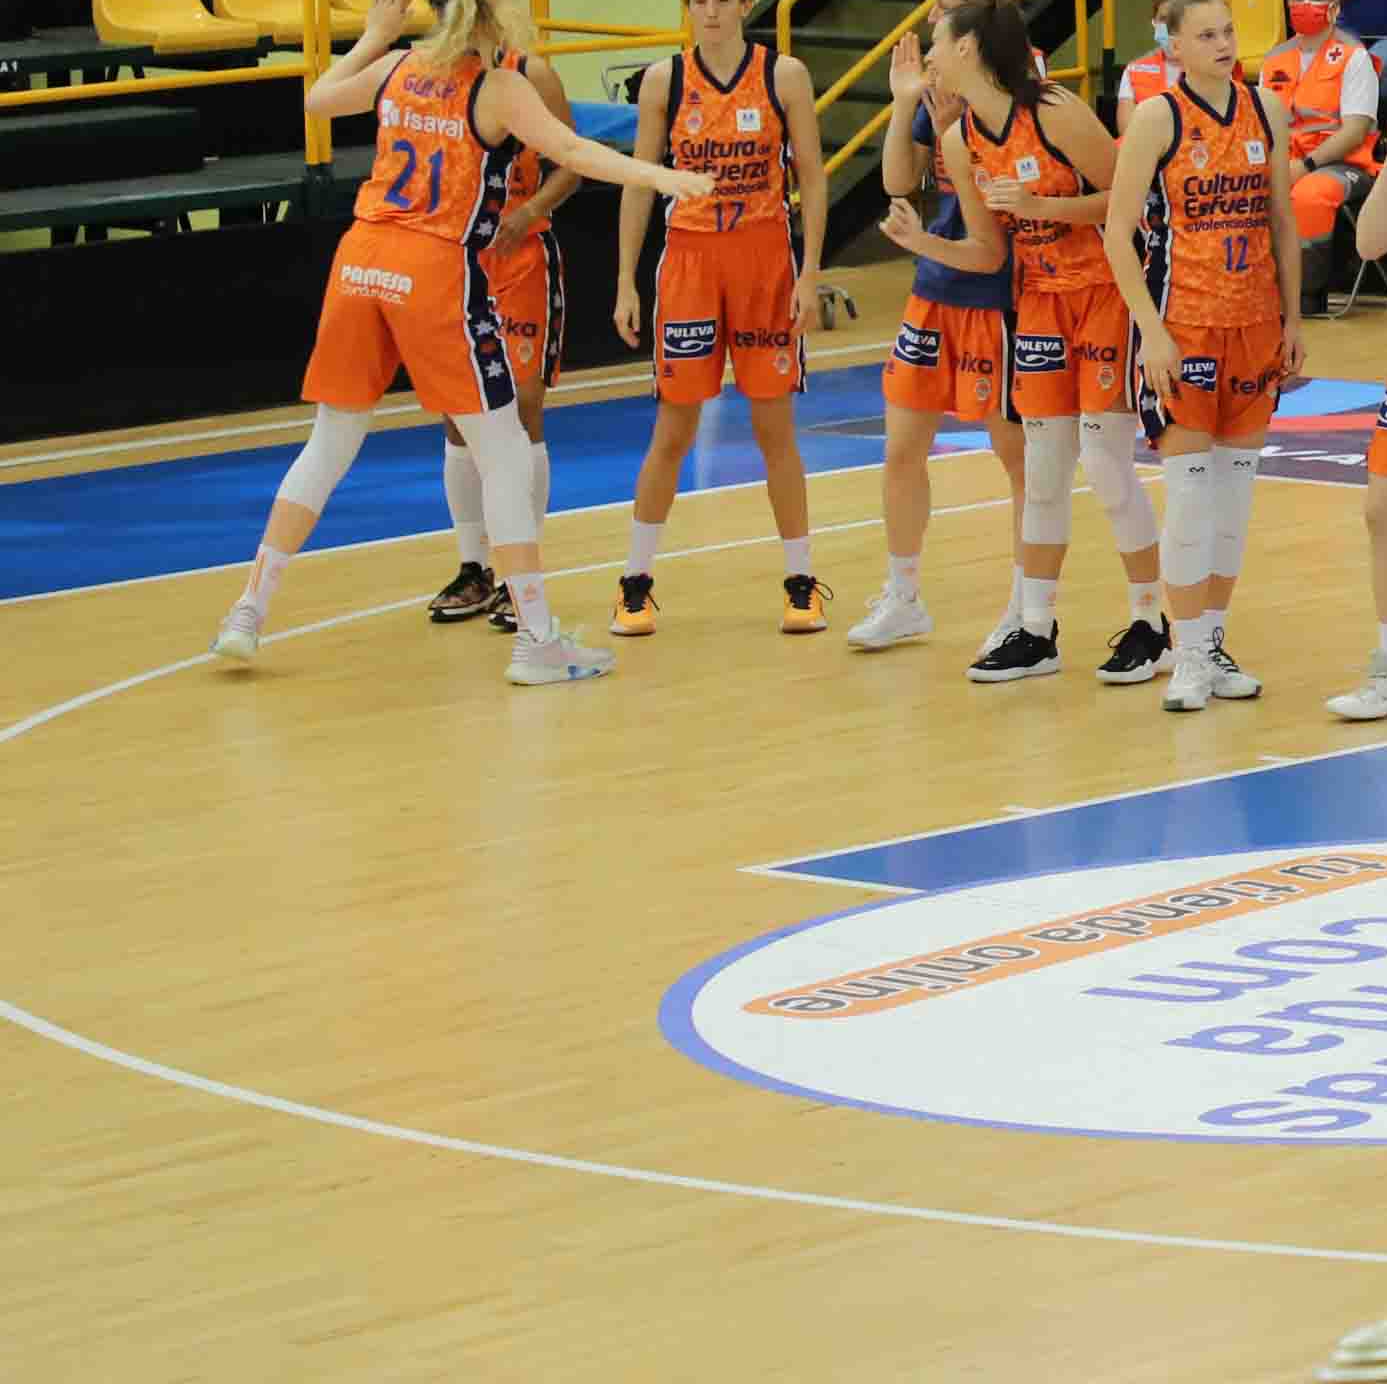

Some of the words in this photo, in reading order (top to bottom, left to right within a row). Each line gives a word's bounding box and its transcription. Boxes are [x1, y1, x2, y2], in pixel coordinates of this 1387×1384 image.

[679, 138, 755, 160] Cultura
[383, 139, 445, 214] 21
[1183, 172, 1265, 197] Cultura
[714, 200, 745, 232] 17
[1221, 234, 1251, 273] 12
[665, 325, 715, 339] PULEVA
[1032, 878, 1286, 950] tienda
[768, 941, 1041, 1018] online
